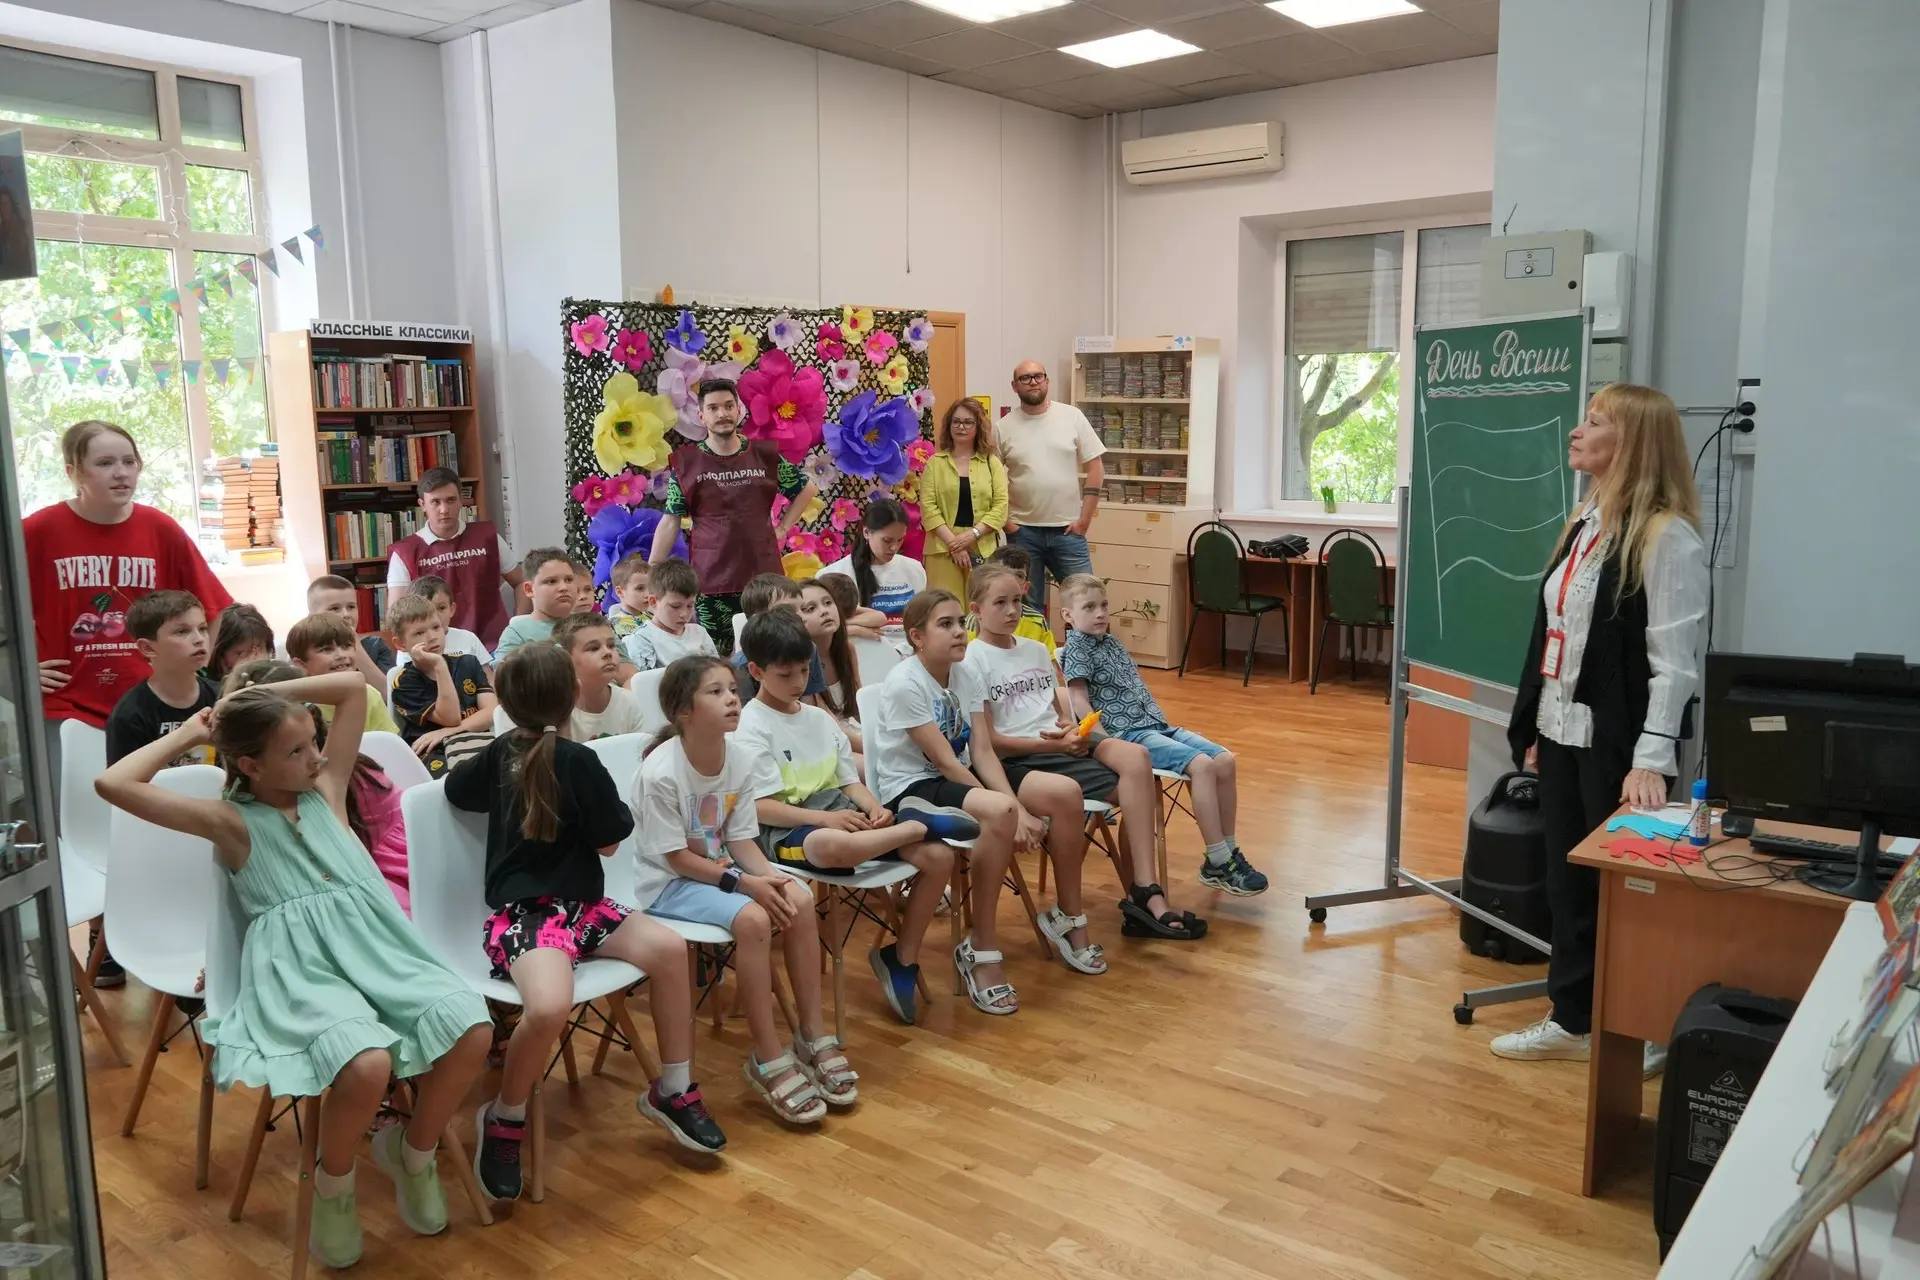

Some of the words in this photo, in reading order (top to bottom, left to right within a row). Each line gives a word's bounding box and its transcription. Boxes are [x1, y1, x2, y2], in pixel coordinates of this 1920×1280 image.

[313, 323, 393, 337] КЛАССНЫЕ
[400, 326, 470, 340] КЛАССИКИ
[1425, 339, 1482, 385] День
[1490, 329, 1573, 379] России
[54, 555, 113, 590] EVERY
[117, 556, 156, 589] BITE
[91, 642, 118, 651] FRESH
[119, 642, 139, 650] BERR
[991, 678, 1034, 701] CREATIVE
[1038, 675, 1053, 690] LIF
[1687, 1089, 1747, 1111] EUROPO
